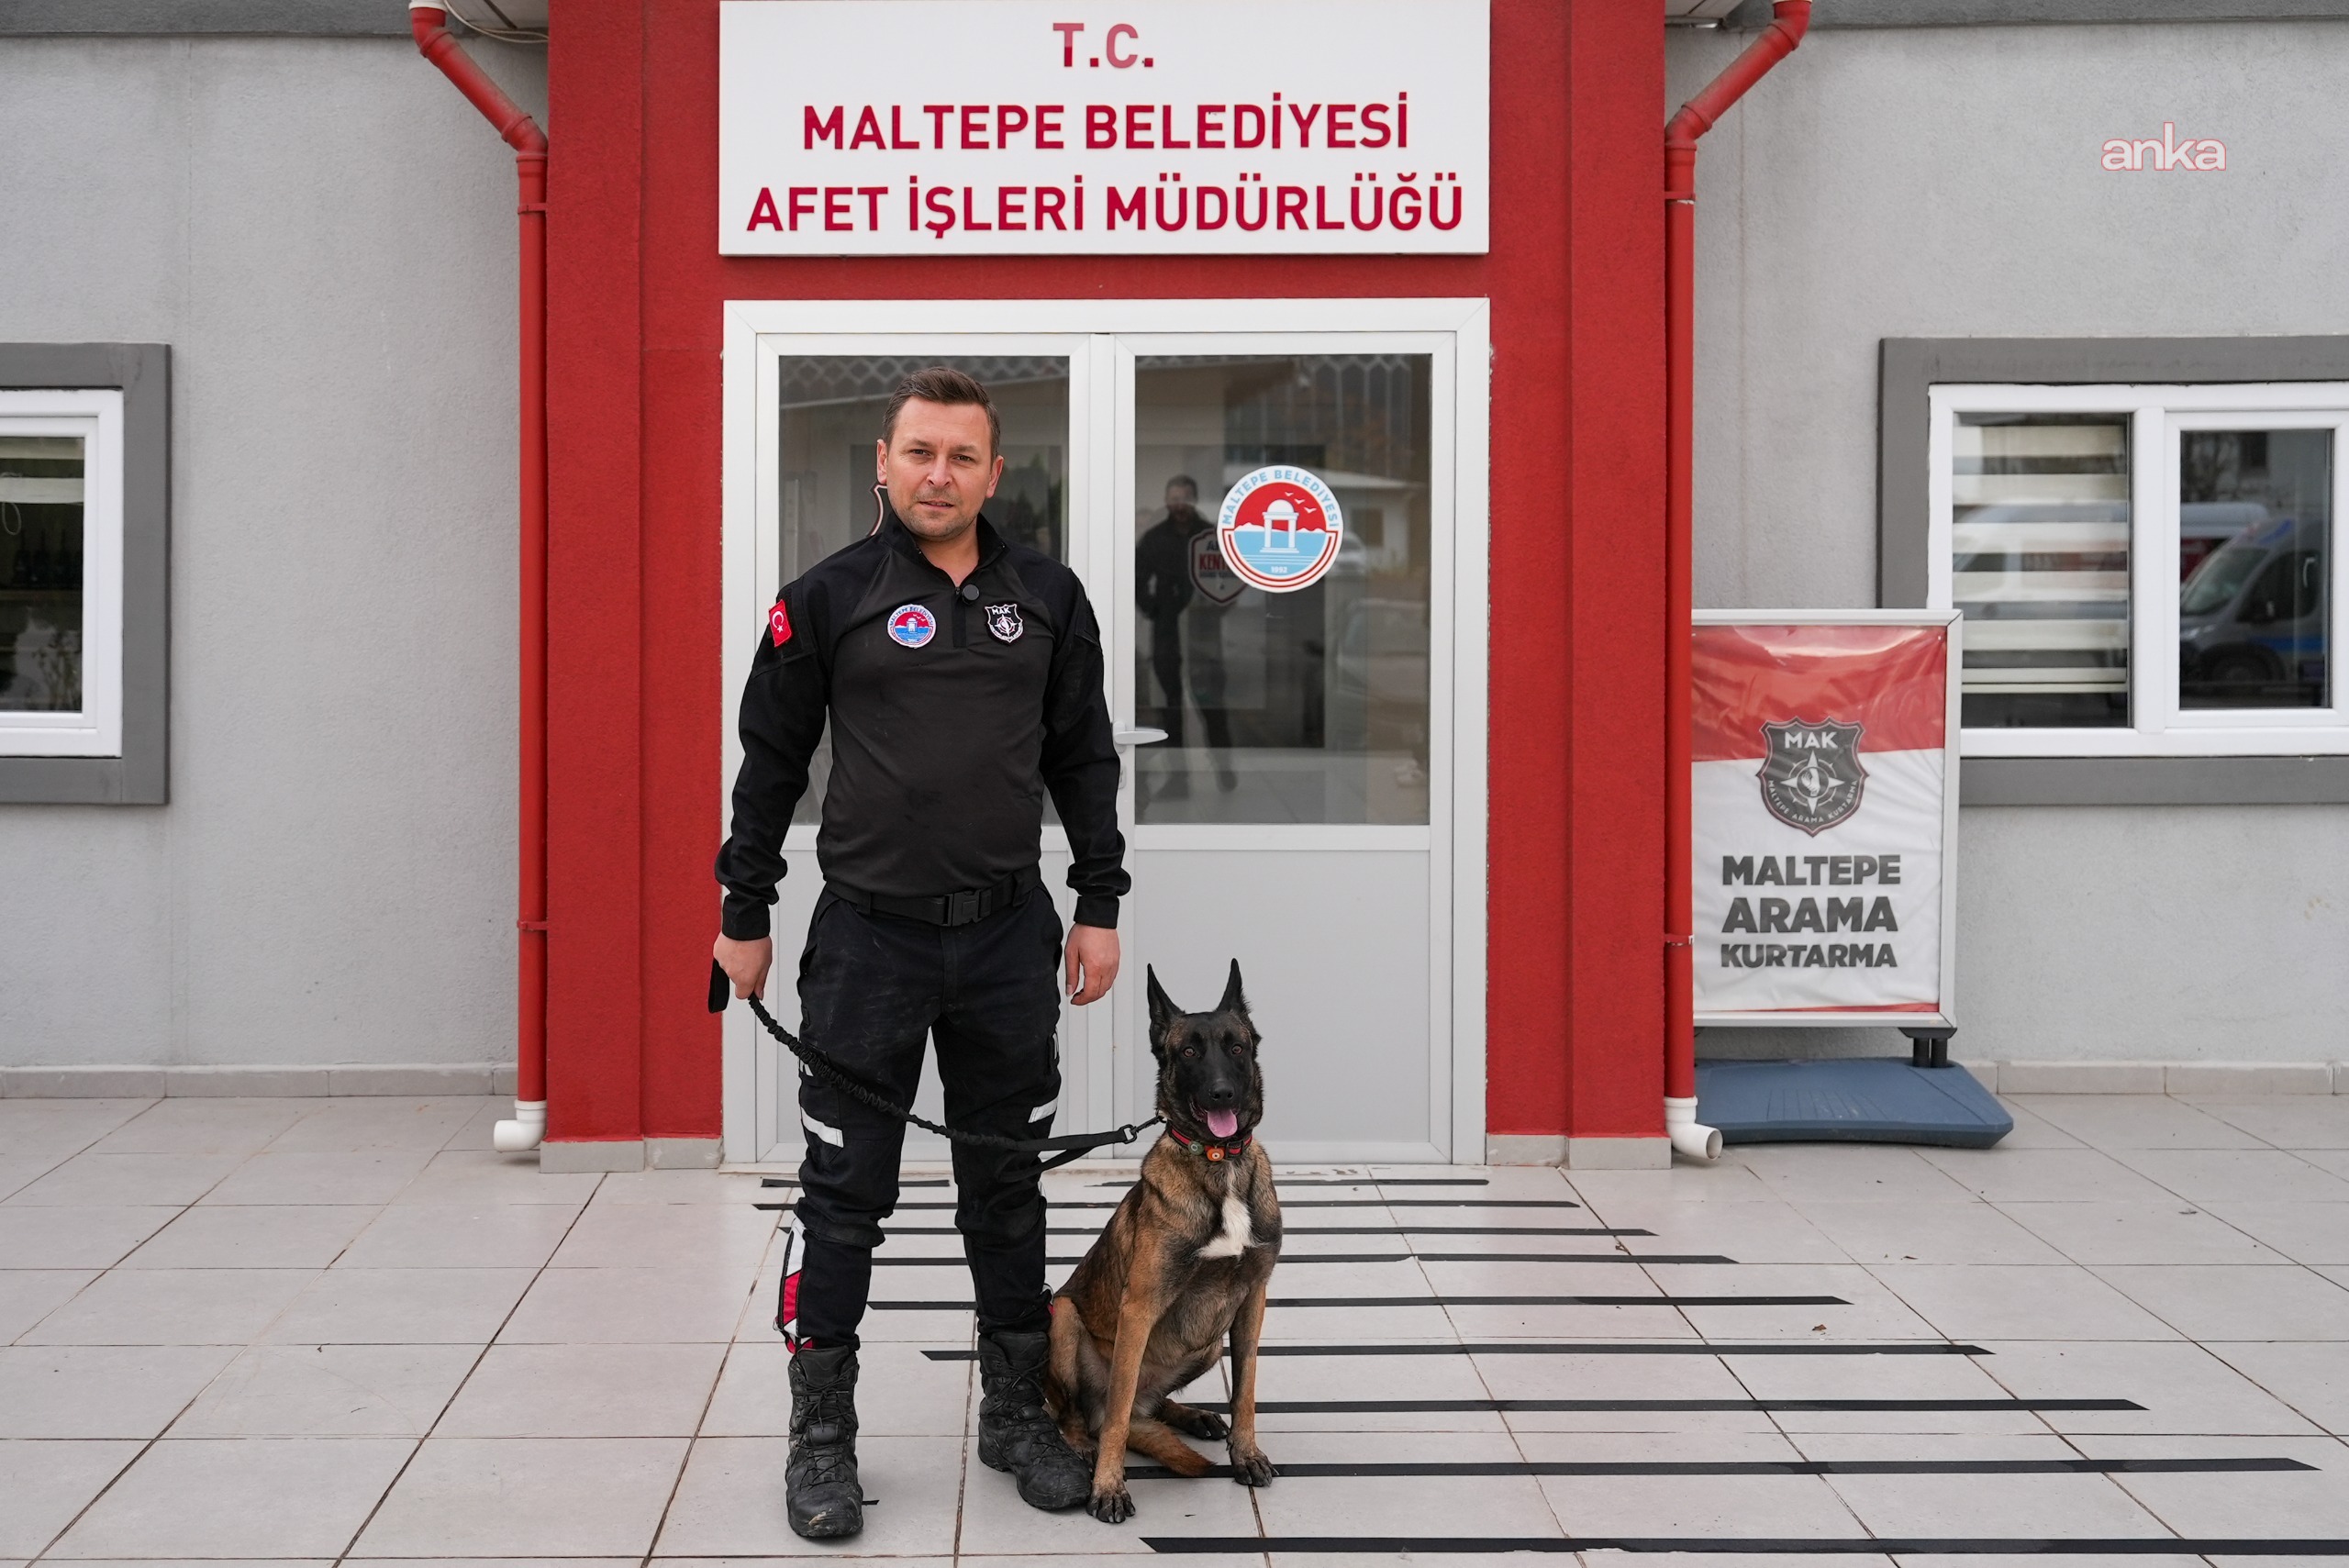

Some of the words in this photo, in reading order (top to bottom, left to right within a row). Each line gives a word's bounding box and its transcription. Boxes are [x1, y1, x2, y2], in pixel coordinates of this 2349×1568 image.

[1053, 23, 1153, 68] T.C.
[805, 105, 1064, 150] MALTEPE
[1085, 92, 1408, 150] BELEDİYESİ
[747, 186, 888, 231] AFET
[909, 174, 1084, 239] İŞLERİ
[1107, 172, 1463, 231] MÜDÜRLÜĞÜ
[1222, 472, 1268, 525] MALTEPE
[1275, 470, 1339, 528] BELEDİYESİ
[991, 606, 1011, 615] MAK
[1784, 731, 1839, 749] MAK
[1768, 780, 1789, 815] MALTEPE
[1792, 813, 1824, 823] ARAMA
[1827, 780, 1858, 820] KURTARMA
[1721, 855, 1901, 885] MALTEPE
[1721, 895, 1898, 933] ARAMA
[1720, 943, 1898, 969] KURTARMA
